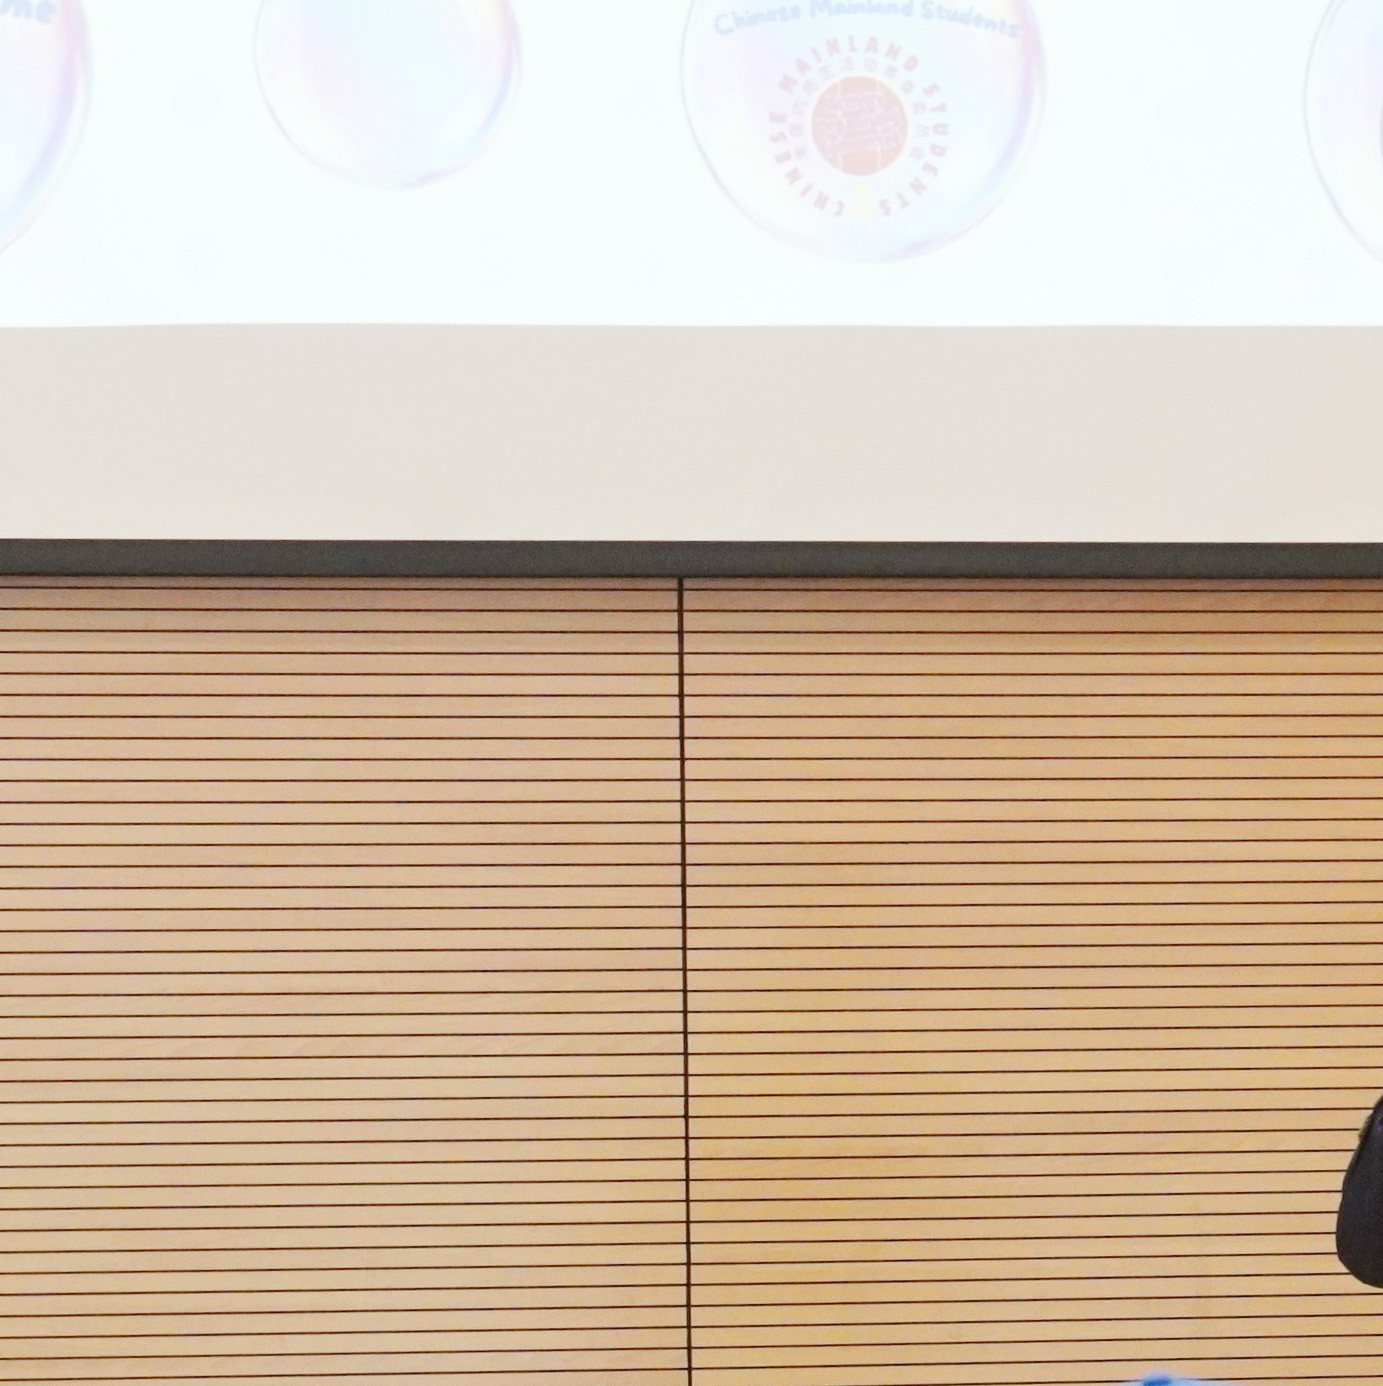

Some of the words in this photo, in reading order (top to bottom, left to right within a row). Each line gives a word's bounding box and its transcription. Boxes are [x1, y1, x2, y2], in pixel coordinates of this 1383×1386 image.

[714, 3, 801, 35] Chinese
[810, 0, 914, 19] Mainland
[921, 0, 1020, 39] Students
[777, 34, 920, 94] MAINLAND
[769, 111, 845, 216] CHINESE
[878, 82, 950, 217] STUDENTS
